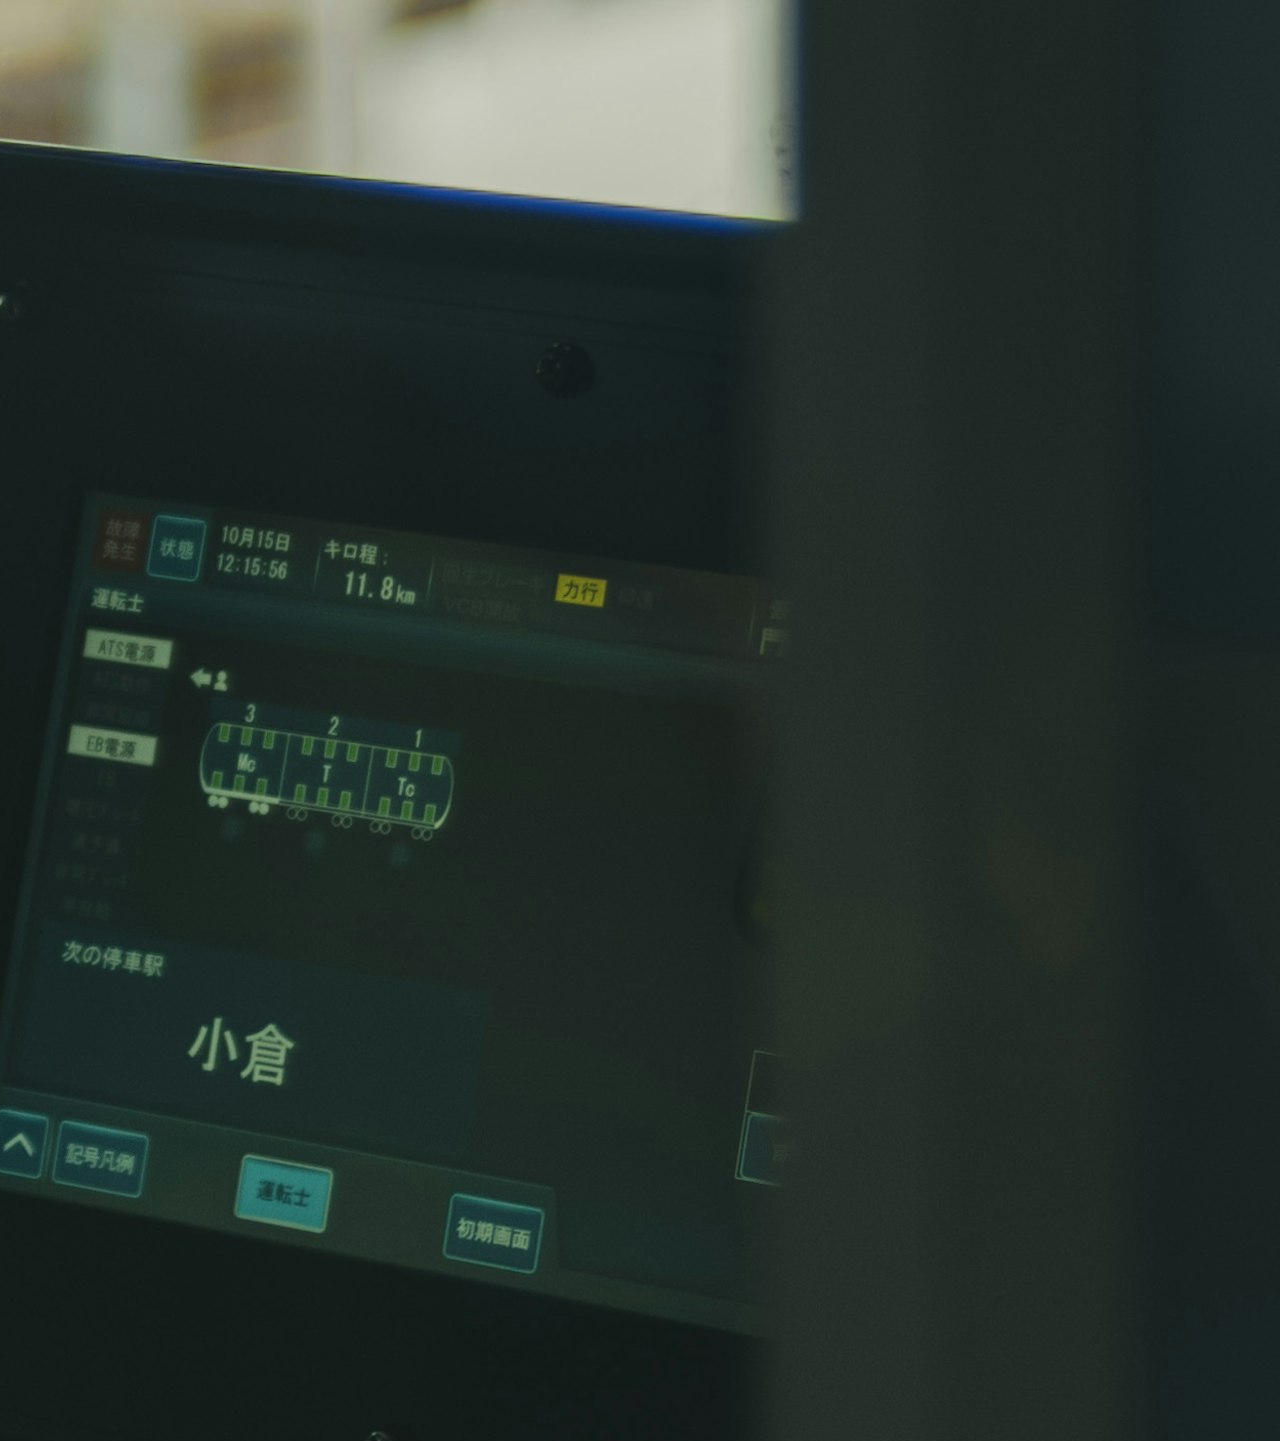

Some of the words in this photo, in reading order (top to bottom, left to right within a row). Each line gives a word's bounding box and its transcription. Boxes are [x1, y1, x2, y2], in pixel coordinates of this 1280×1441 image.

[102, 540, 138, 562] 発生
[159, 534, 195, 561] 状態
[220, 524, 291, 553] 10月15日
[216, 552, 289, 580] 12:15:56
[90, 587, 145, 614] 運転士
[561, 579, 599, 604] 力行
[96, 637, 157, 664] ATS電源
[244, 703, 257, 723] 3
[327, 716, 341, 737] 2
[414, 728, 424, 748] 1
[86, 735, 137, 760] EB電源
[236, 752, 257, 773] Mc
[322, 764, 332, 783] T
[397, 776, 416, 797] Tc
[60, 939, 167, 979] 次の停車駅
[186, 1014, 297, 1088] 小倉
[255, 1178, 311, 1208] 運転士
[455, 1215, 532, 1253] 初期画面
